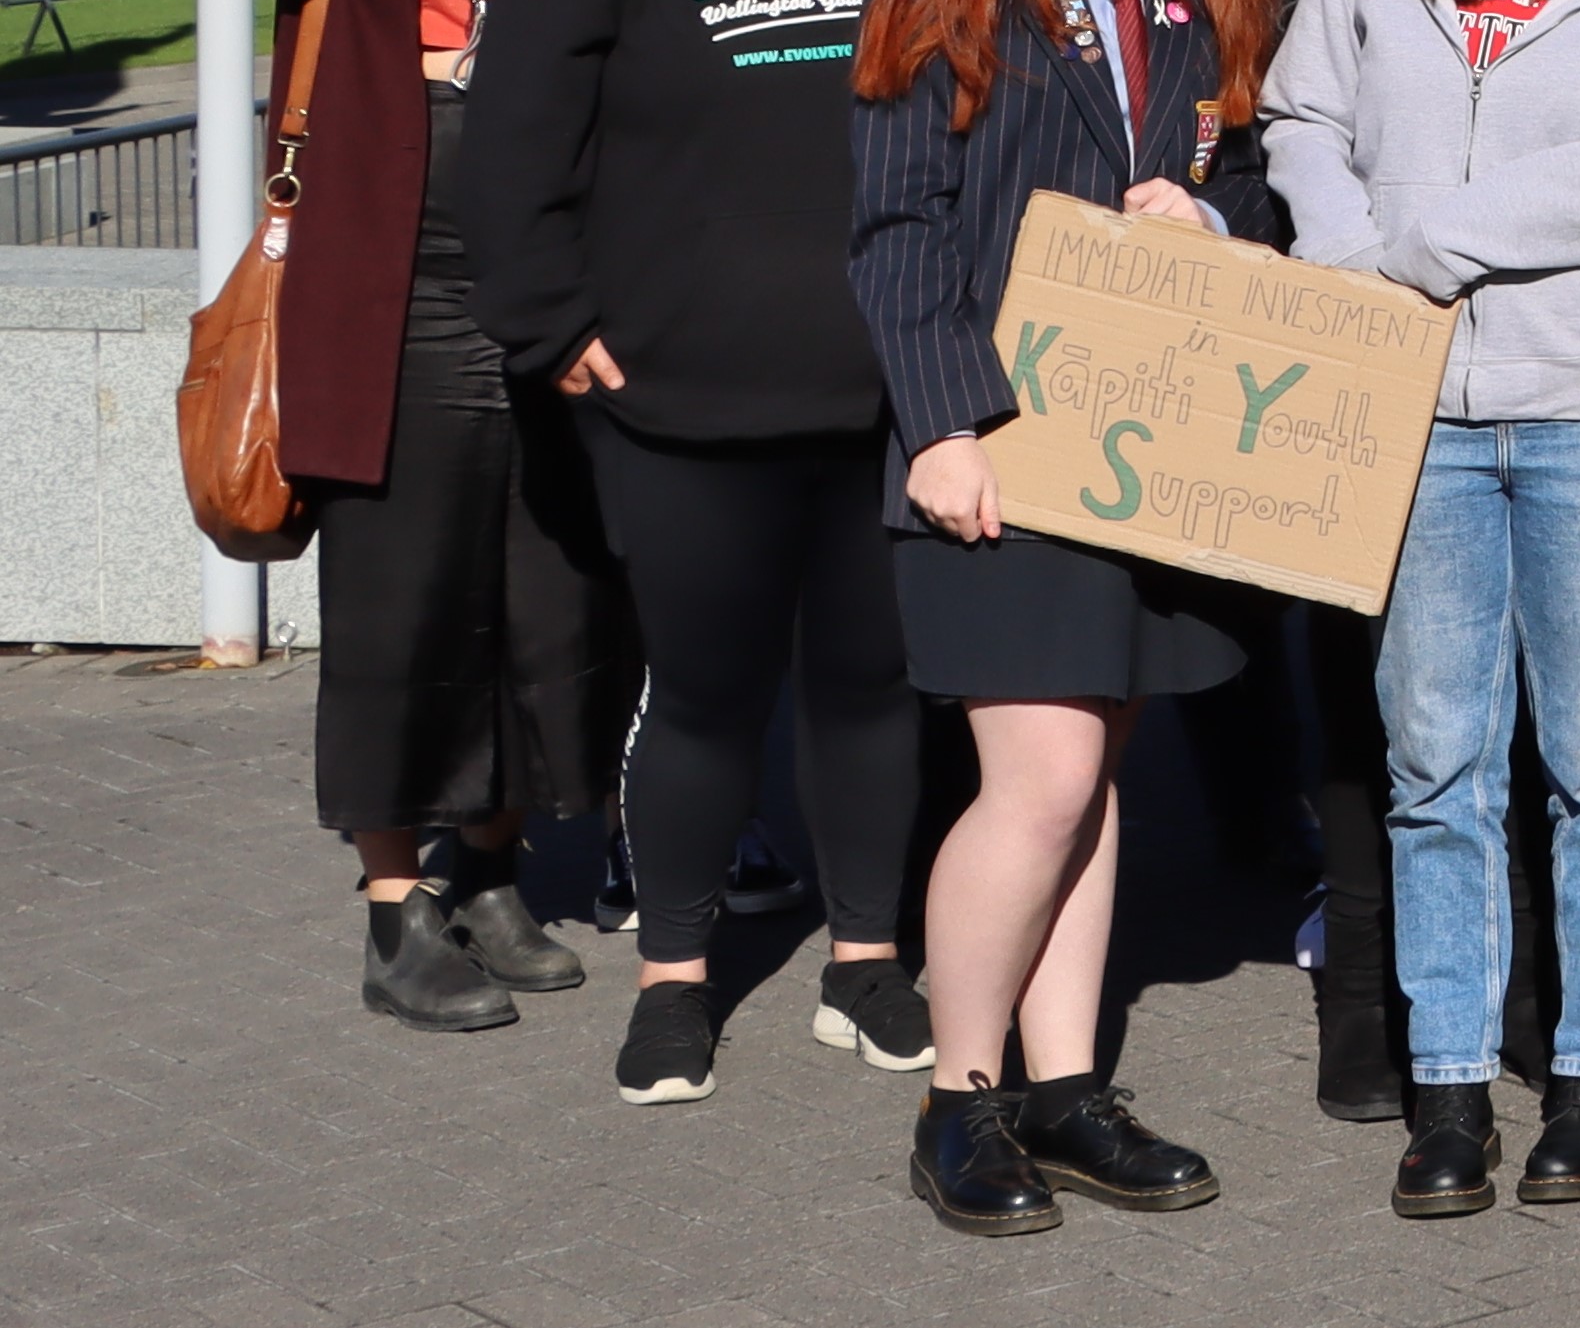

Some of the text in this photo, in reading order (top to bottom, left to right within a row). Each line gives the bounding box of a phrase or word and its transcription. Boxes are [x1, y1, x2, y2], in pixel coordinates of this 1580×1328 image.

[1042, 227, 1450, 358] IMMEDIATE INVESTMENT
[1181, 320, 1220, 357] in
[1009, 320, 1379, 468] Kāpiti Youth
[1080, 420, 1340, 549] Support
